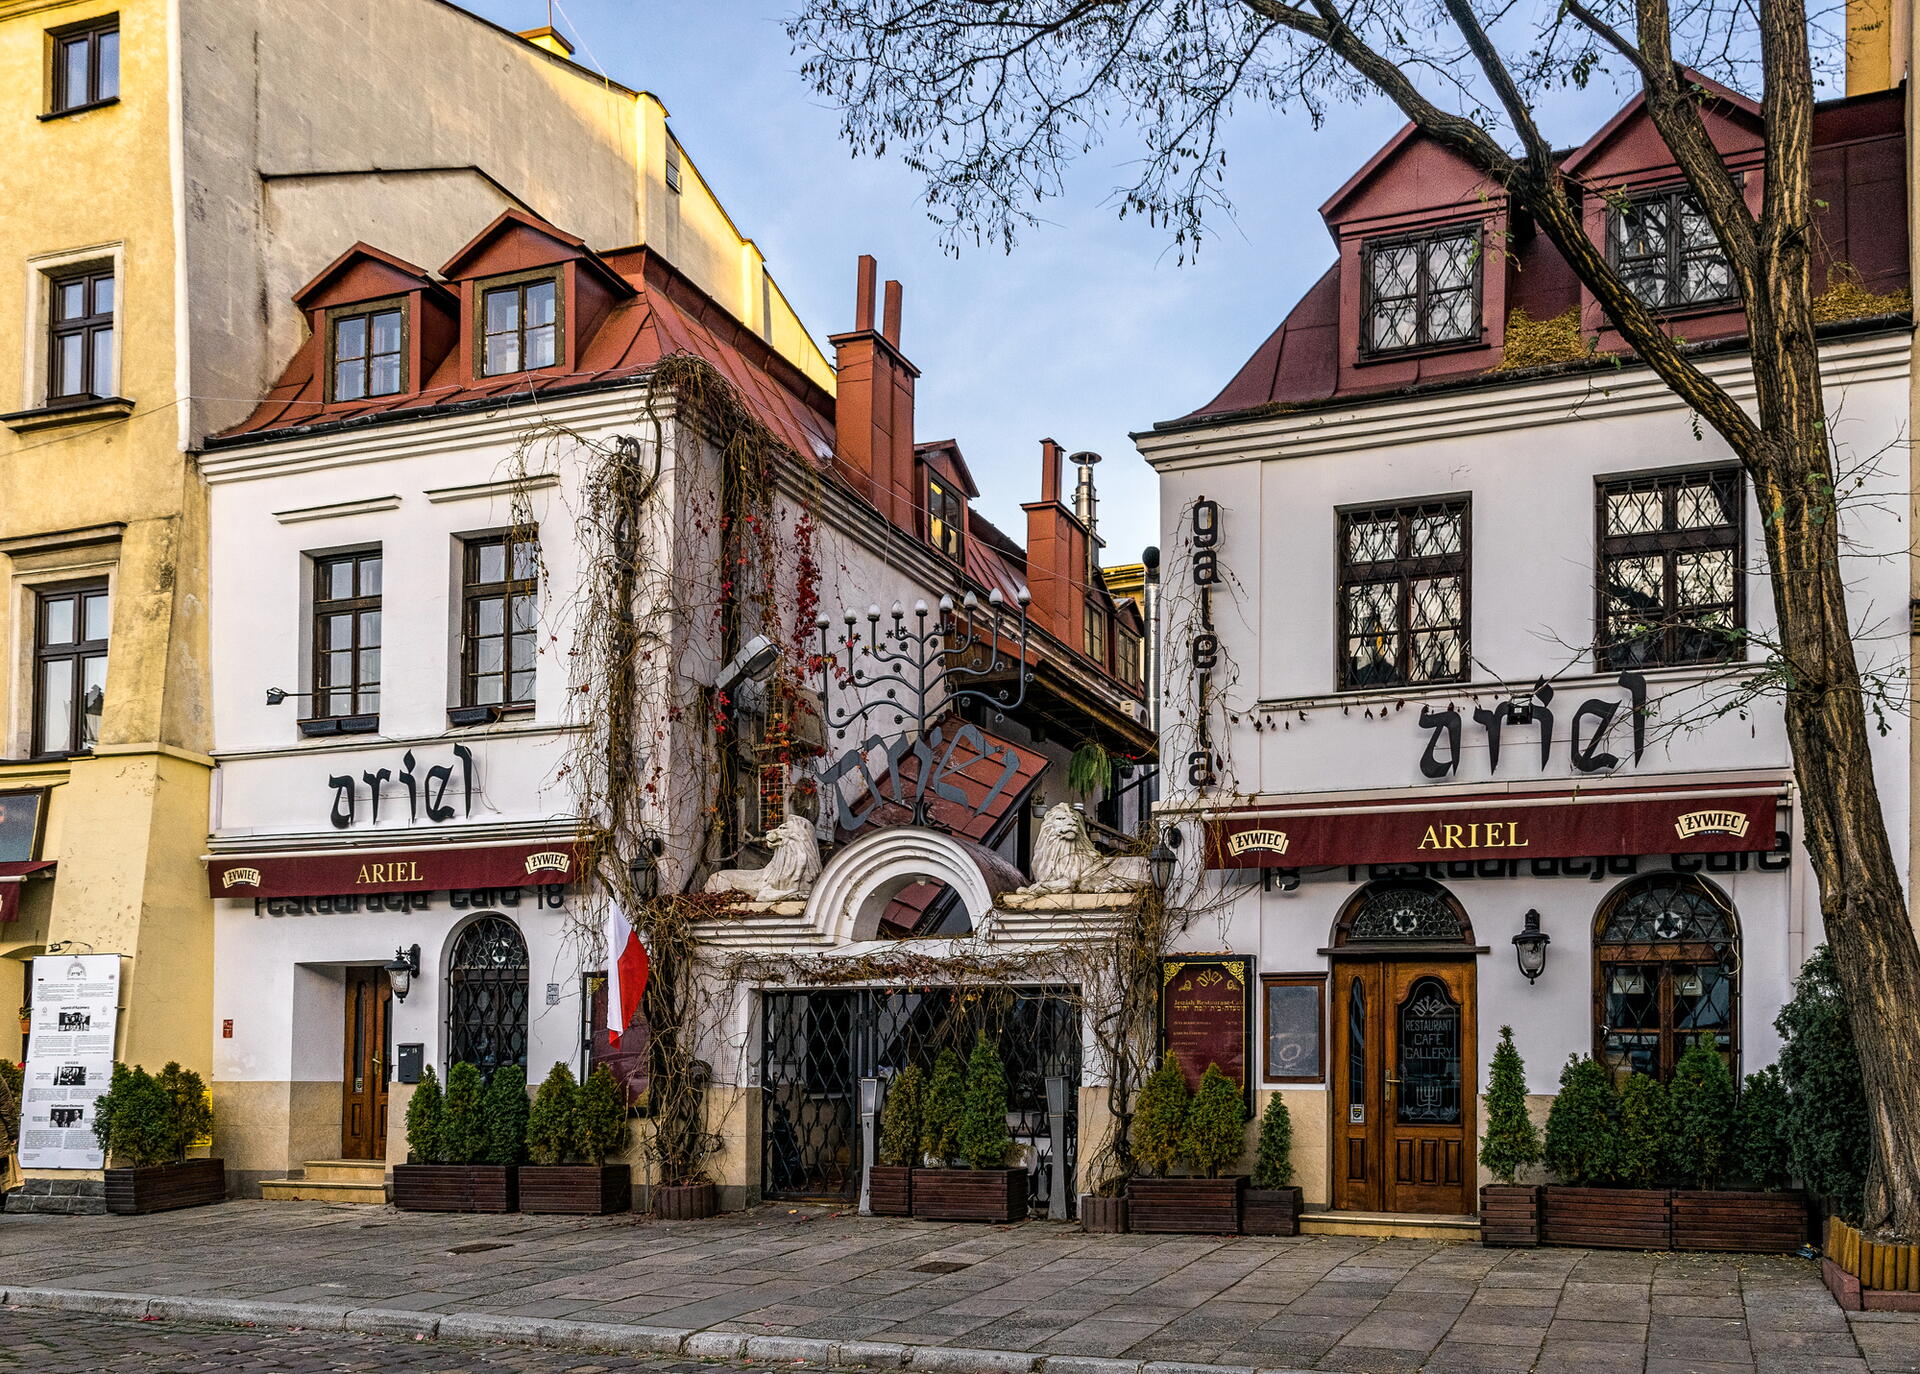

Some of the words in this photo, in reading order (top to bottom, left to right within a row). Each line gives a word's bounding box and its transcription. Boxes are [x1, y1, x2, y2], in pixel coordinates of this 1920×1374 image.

[1418, 669, 1647, 778] ariel
[328, 742, 472, 829] ariel
[1417, 821, 1529, 850] ARIEL
[355, 861, 424, 885] ARIEL
[1405, 1020, 1453, 1032] RESTAURANT
[1414, 1033, 1445, 1046] CAFE
[1405, 1047, 1453, 1060] GALLERY
